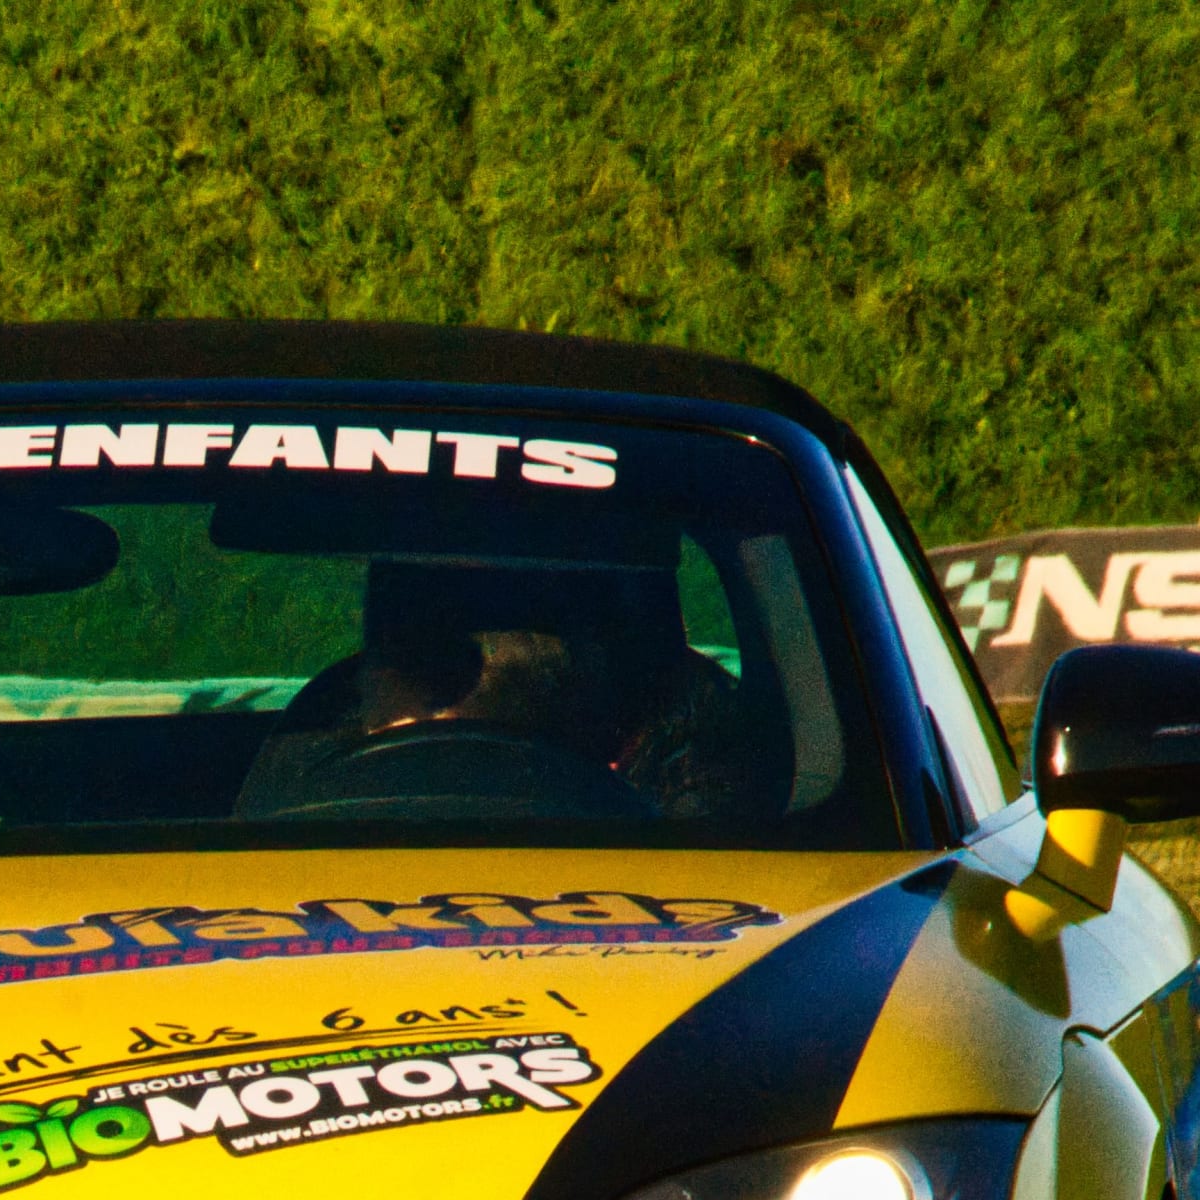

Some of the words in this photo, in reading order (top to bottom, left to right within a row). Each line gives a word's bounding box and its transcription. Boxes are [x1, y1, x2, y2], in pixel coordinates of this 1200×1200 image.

[322, 893, 757, 934] kids
[127, 1022, 258, 1054] dès
[321, 1007, 365, 1032] 6
[93, 1085, 126, 1103] JE
[128, 1069, 222, 1096] ROULE
[227, 1062, 266, 1080] AU
[494, 1033, 566, 1049] AVEC
